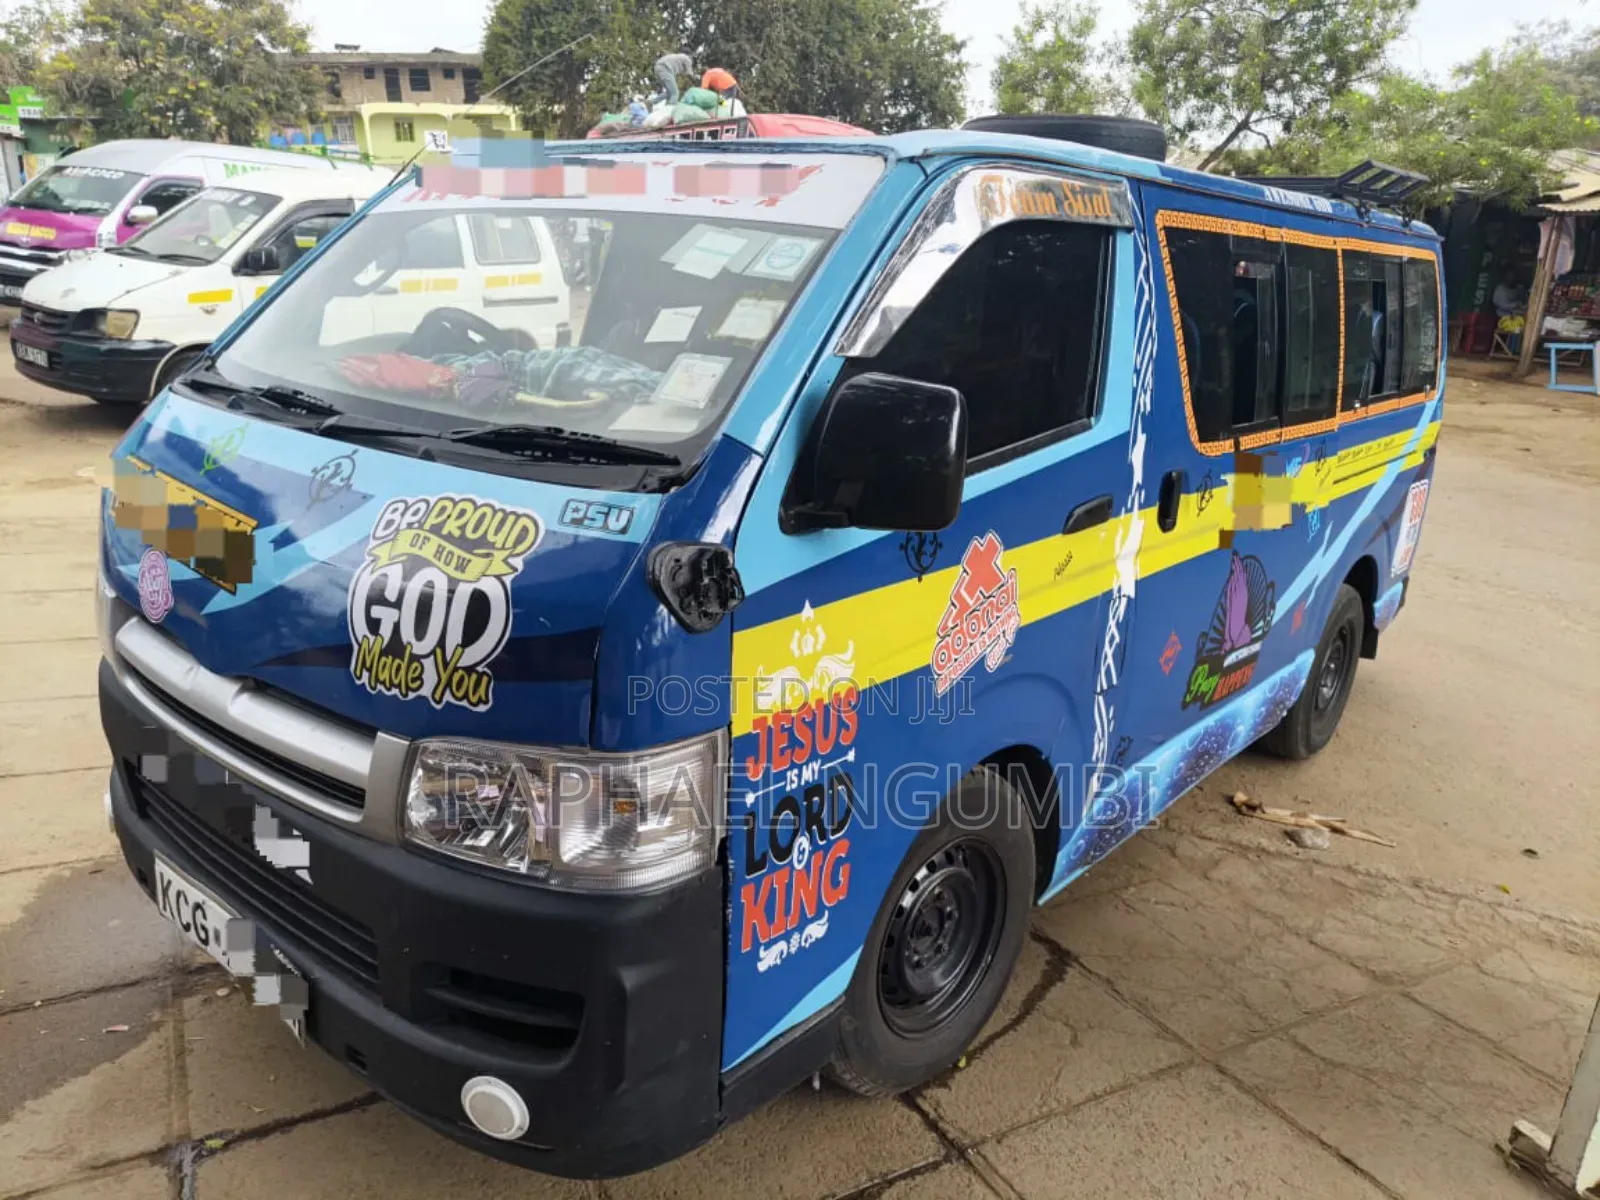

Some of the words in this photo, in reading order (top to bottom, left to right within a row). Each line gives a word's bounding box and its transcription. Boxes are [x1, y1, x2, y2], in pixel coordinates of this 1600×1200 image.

[409, 532, 431, 551] OF
[432, 543, 473, 575] HOW
[423, 498, 539, 556] PROUD
[560, 499, 634, 535] PSV
[351, 563, 507, 670] GOD
[354, 634, 424, 698] Made
[431, 644, 493, 706] You
[746, 685, 858, 781] JESUS
[786, 768, 800, 792] IS
[801, 759, 821, 786] MY
[744, 773, 855, 879] LORD
[160, 871, 210, 947] KCG
[741, 838, 851, 953] KING
